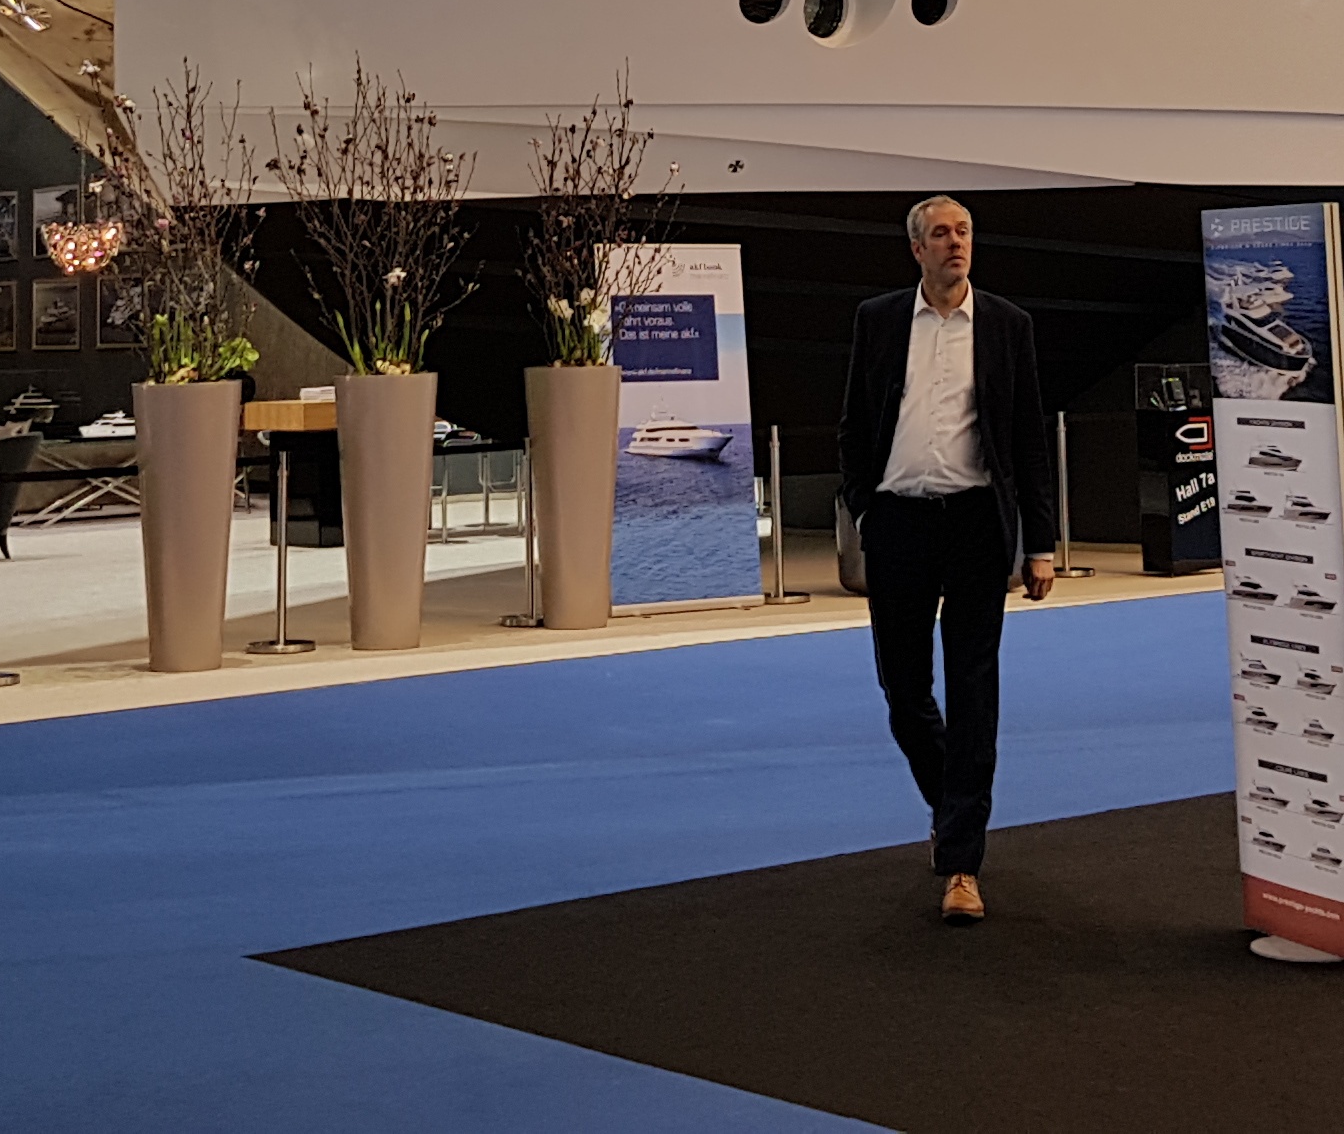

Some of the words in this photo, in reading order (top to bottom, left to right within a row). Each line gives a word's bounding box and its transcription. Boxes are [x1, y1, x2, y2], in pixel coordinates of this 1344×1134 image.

[1230, 215, 1311, 233] PRESTIGE
[618, 328, 637, 341] Das
[1175, 477, 1200, 502] Hall
[1199, 471, 1216, 488] 7a
